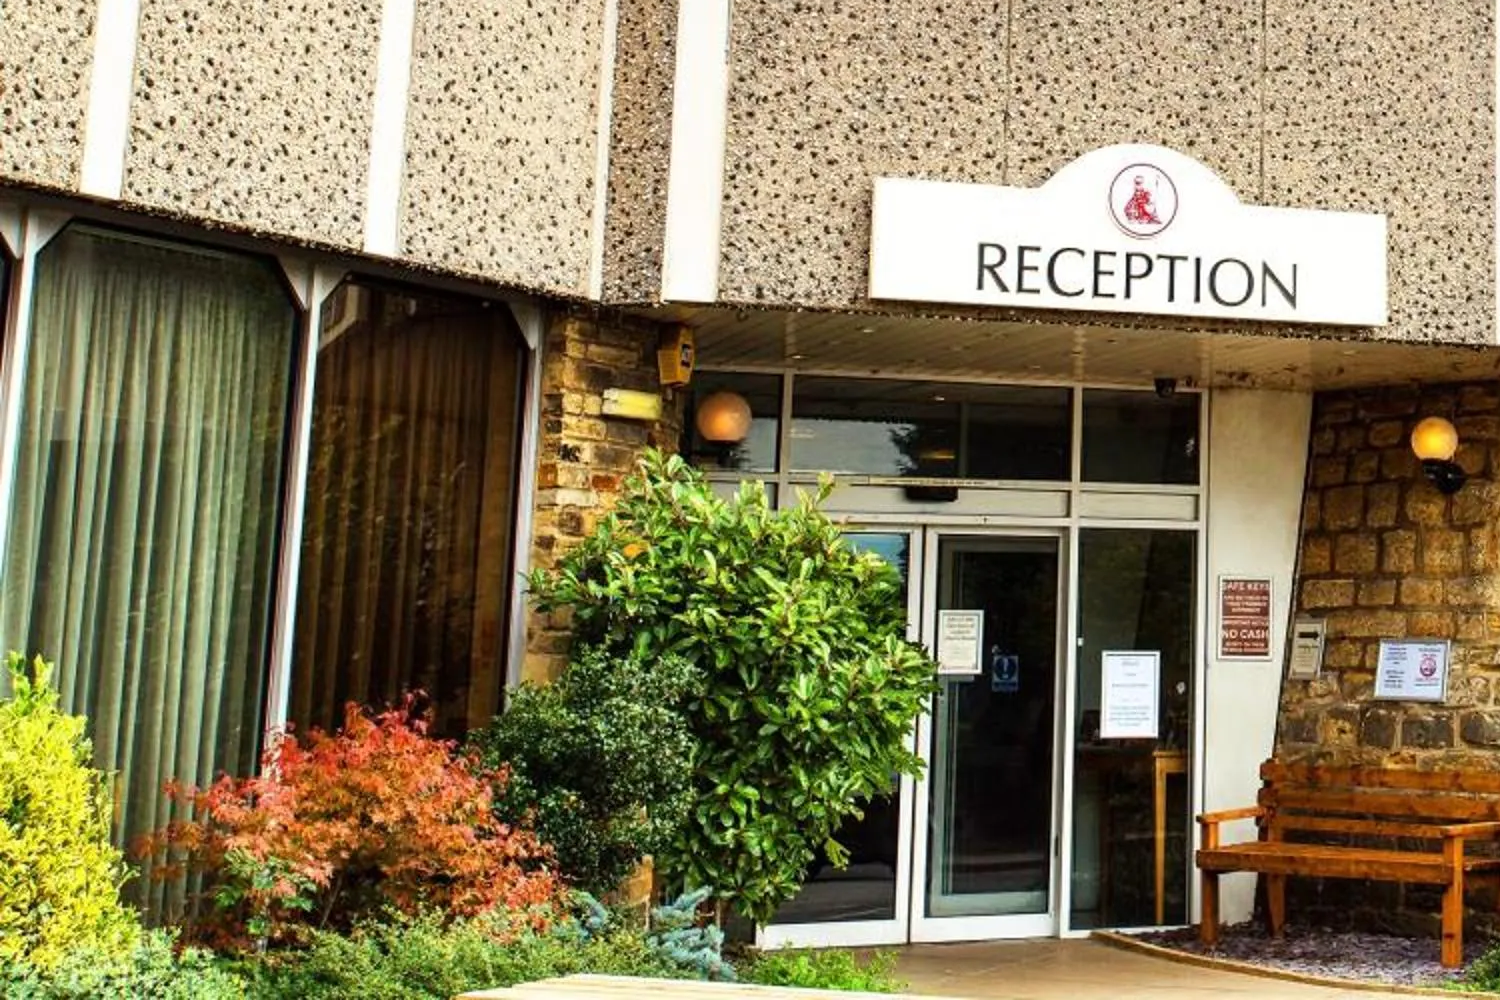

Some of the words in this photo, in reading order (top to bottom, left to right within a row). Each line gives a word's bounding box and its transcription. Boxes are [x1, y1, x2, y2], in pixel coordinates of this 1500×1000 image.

[976, 242, 1298, 309] RECEPTION
[1221, 629, 1238, 639] NO
[1240, 629, 1269, 639] CASH
